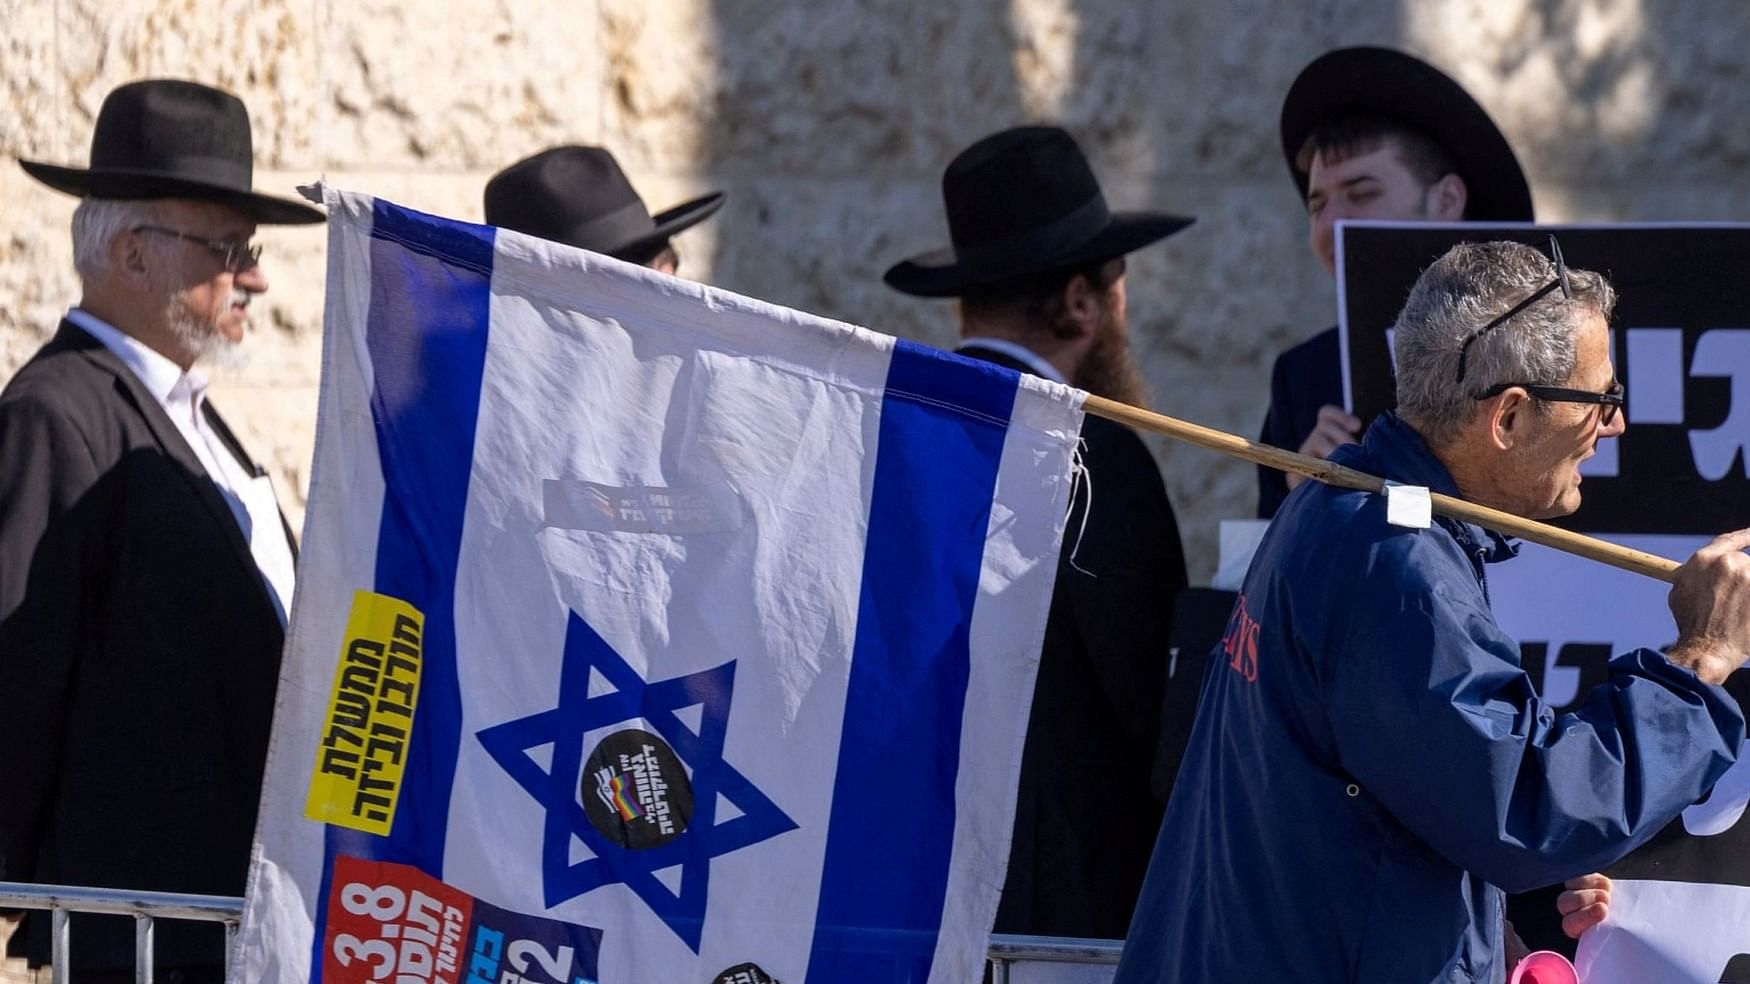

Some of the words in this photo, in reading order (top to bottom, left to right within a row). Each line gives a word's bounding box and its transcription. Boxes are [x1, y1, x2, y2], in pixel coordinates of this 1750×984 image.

[320, 638, 384, 780] ממשלת
[377, 614, 420, 717] חורבן
[352, 722, 406, 822] וביזה
[632, 753, 652, 804] גאווה
[643, 744, 674, 835] דמוקרטיה
[333, 882, 407, 980] 3.8
[433, 906, 464, 973] לחינוך
[507, 938, 575, 983] 2
